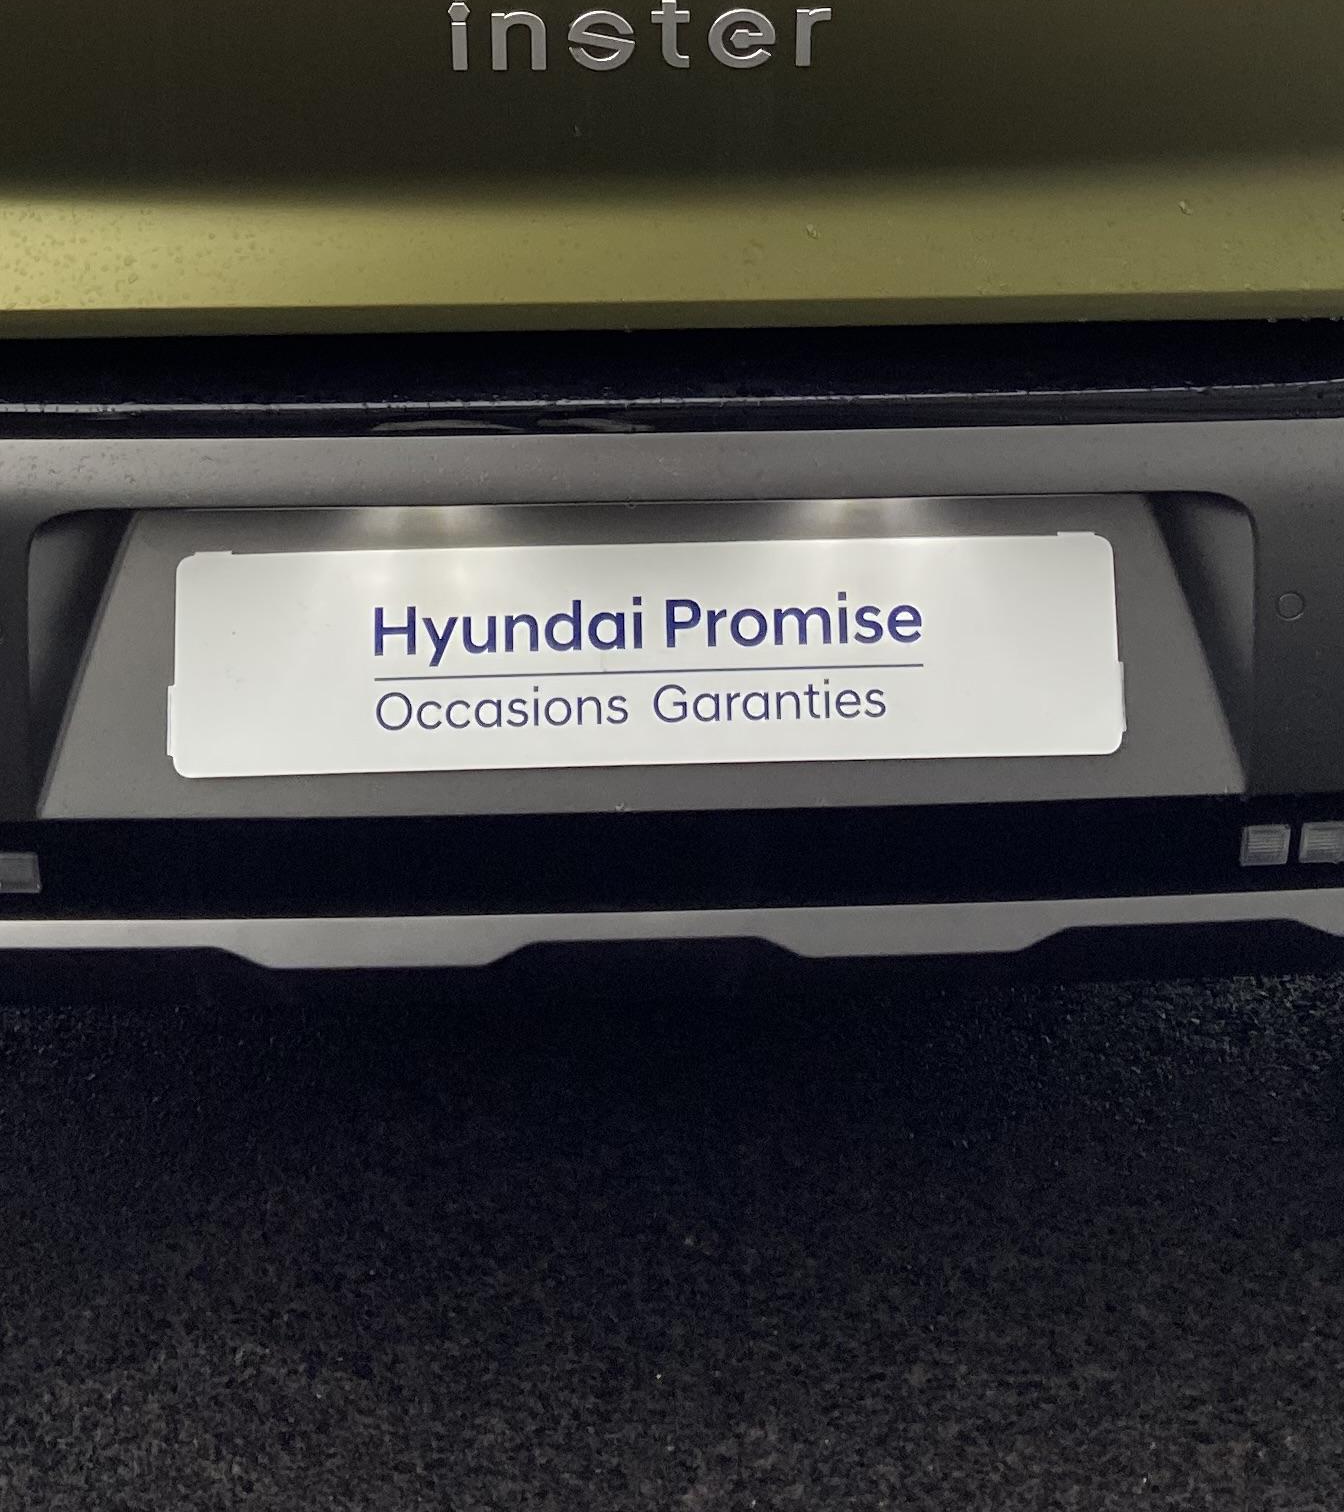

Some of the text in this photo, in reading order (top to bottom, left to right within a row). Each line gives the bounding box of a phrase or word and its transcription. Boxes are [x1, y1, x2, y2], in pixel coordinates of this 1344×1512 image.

[448, 0, 832, 71] inster
[373, 591, 923, 667] Hyundai Promise
[375, 679, 887, 731] Occasions Garanties
